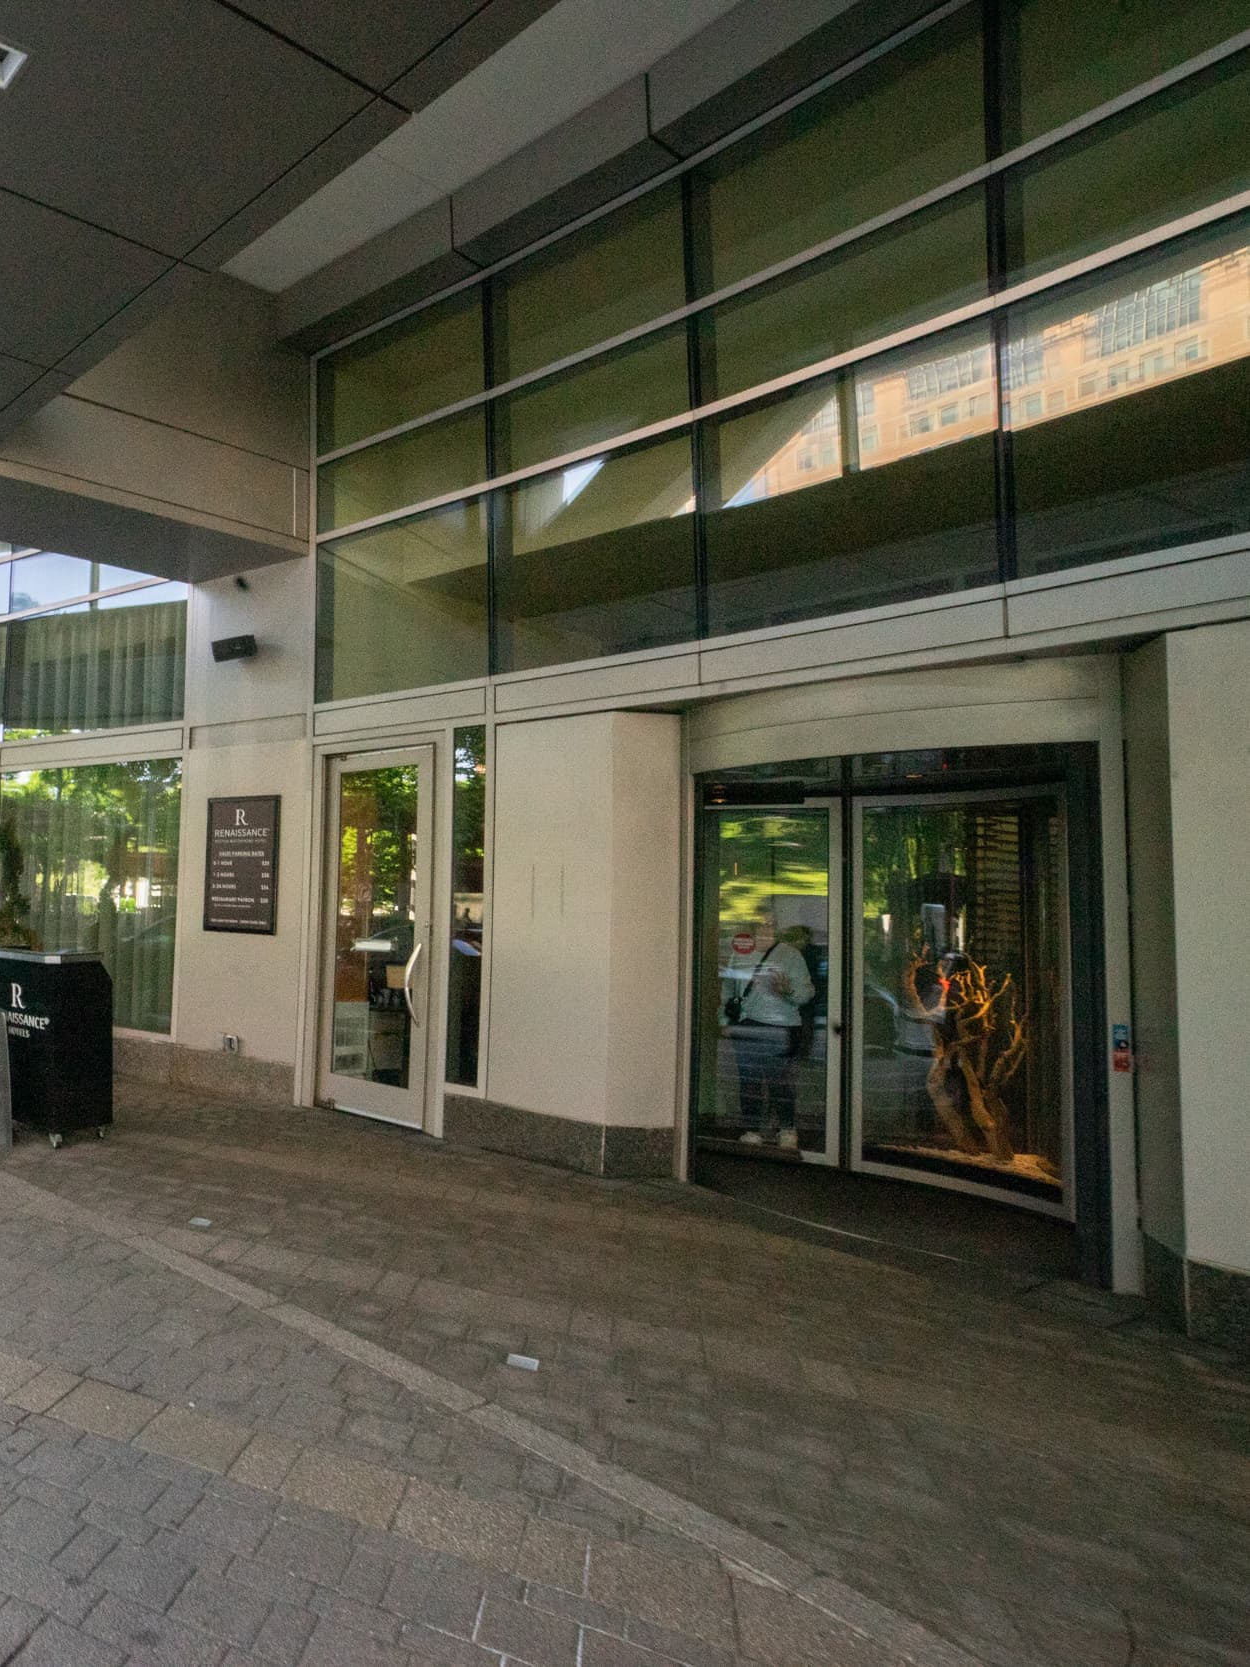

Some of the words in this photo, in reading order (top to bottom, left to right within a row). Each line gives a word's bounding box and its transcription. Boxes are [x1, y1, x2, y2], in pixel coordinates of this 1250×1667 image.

[235, 808, 249, 826] R
[214, 828, 269, 838] RENAISSANCE
[11, 982, 27, 1009] R
